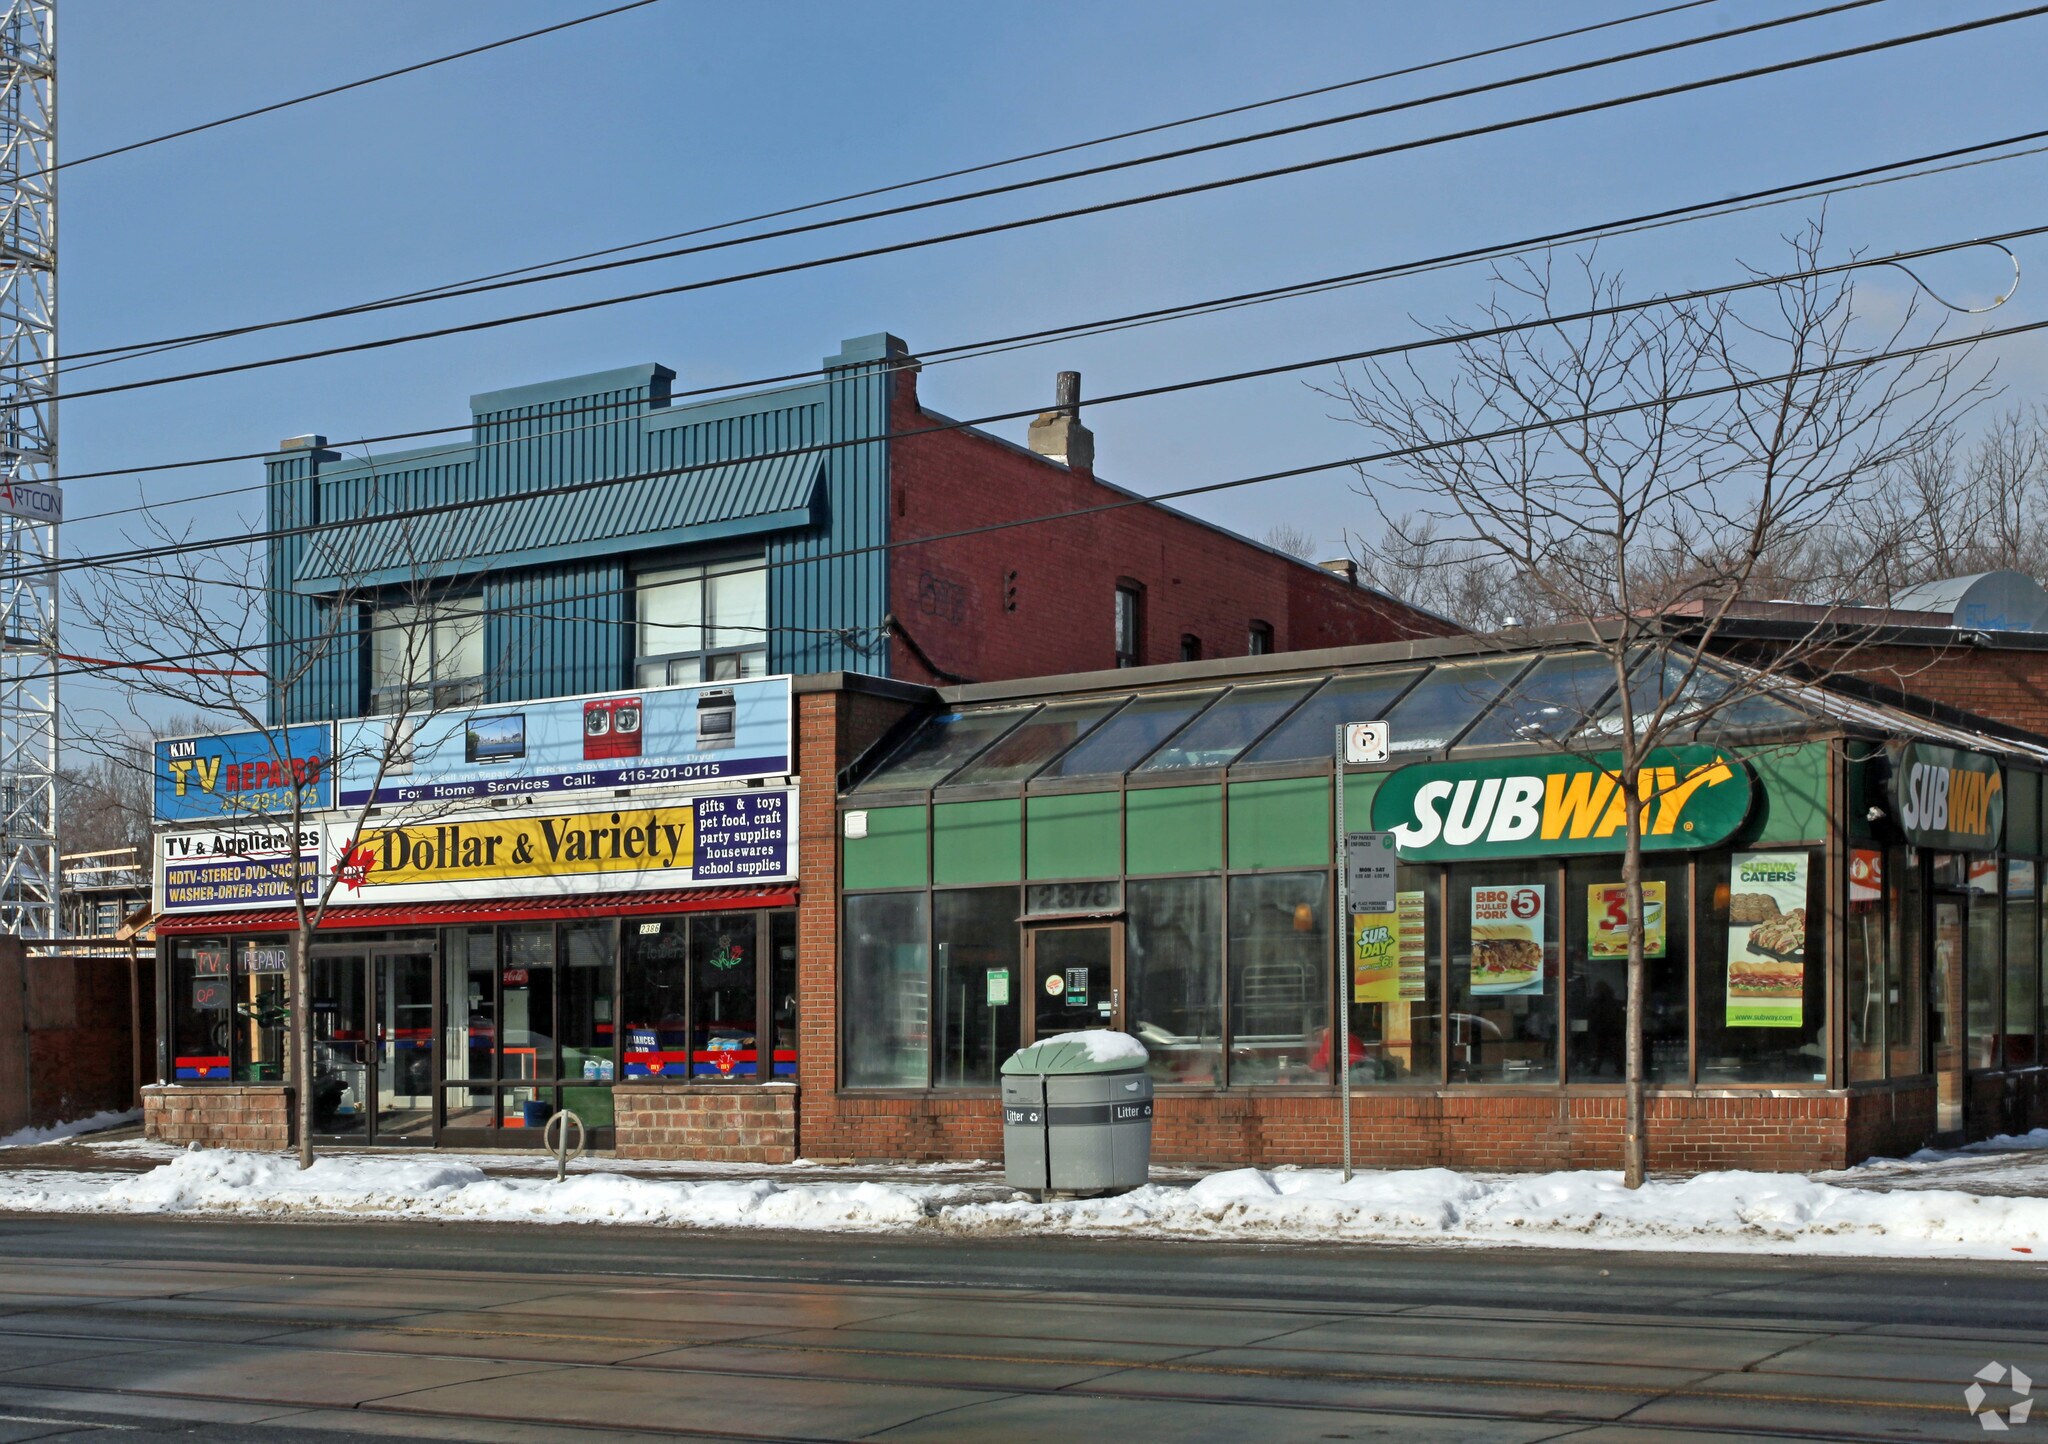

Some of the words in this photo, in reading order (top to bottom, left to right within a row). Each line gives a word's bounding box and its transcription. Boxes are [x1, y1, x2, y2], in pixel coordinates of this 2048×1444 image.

[169, 741, 196, 758] KIM
[169, 755, 222, 796] TV
[226, 756, 321, 793] REPAIRS
[399, 788, 422, 800] For
[434, 785, 475, 798] Home
[487, 778, 550, 793] Services
[563, 775, 596, 787] Call:
[618, 764, 720, 782] 416-201-0115
[221, 788, 317, 811] 416-201-015
[699, 799, 725, 816] gifts
[736, 798, 745, 810] &
[757, 797, 781, 811] toys
[1388, 755, 1733, 853] SUBWAY
[1902, 762, 2001, 836] SUBWAY
[700, 816, 718, 831] pet
[722, 813, 750, 827] food,
[754, 811, 782, 824] craft
[165, 837, 191, 856] TV
[196, 842, 206, 855] &
[380, 826, 502, 872] Dollar
[511, 833, 534, 865] &
[538, 813, 686, 868] Variety
[700, 831, 730, 847] party
[734, 827, 782, 844] supplies
[706, 845, 774, 859] housewares
[168, 861, 317, 885] HDTV-STEREO-DVD-VACUM
[699, 861, 734, 875] school
[737, 858, 781, 875] supplies
[1740, 862, 1797, 873] SUBWAY
[1740, 871, 1796, 882] CATERS
[168, 880, 316, 902] WASHER-DRYER-STOVE-TC.
[1475, 890, 1508, 903] BBQ
[1475, 903, 1508, 911] PULLED
[1475, 911, 1508, 919] PORK
[640, 922, 660, 934] 2386
[1358, 927, 1389, 946] SUB
[1361, 938, 1394, 958] DAY
[197, 951, 220, 973] TV
[244, 950, 287, 971] REPAIR
[1735, 1013, 1793, 1022] www.subway.com
[650, 1063, 660, 1072] my
[720, 1063, 731, 1072] my
[1006, 1109, 1024, 1122] Litter
[1117, 1106, 1139, 1119] Litter
